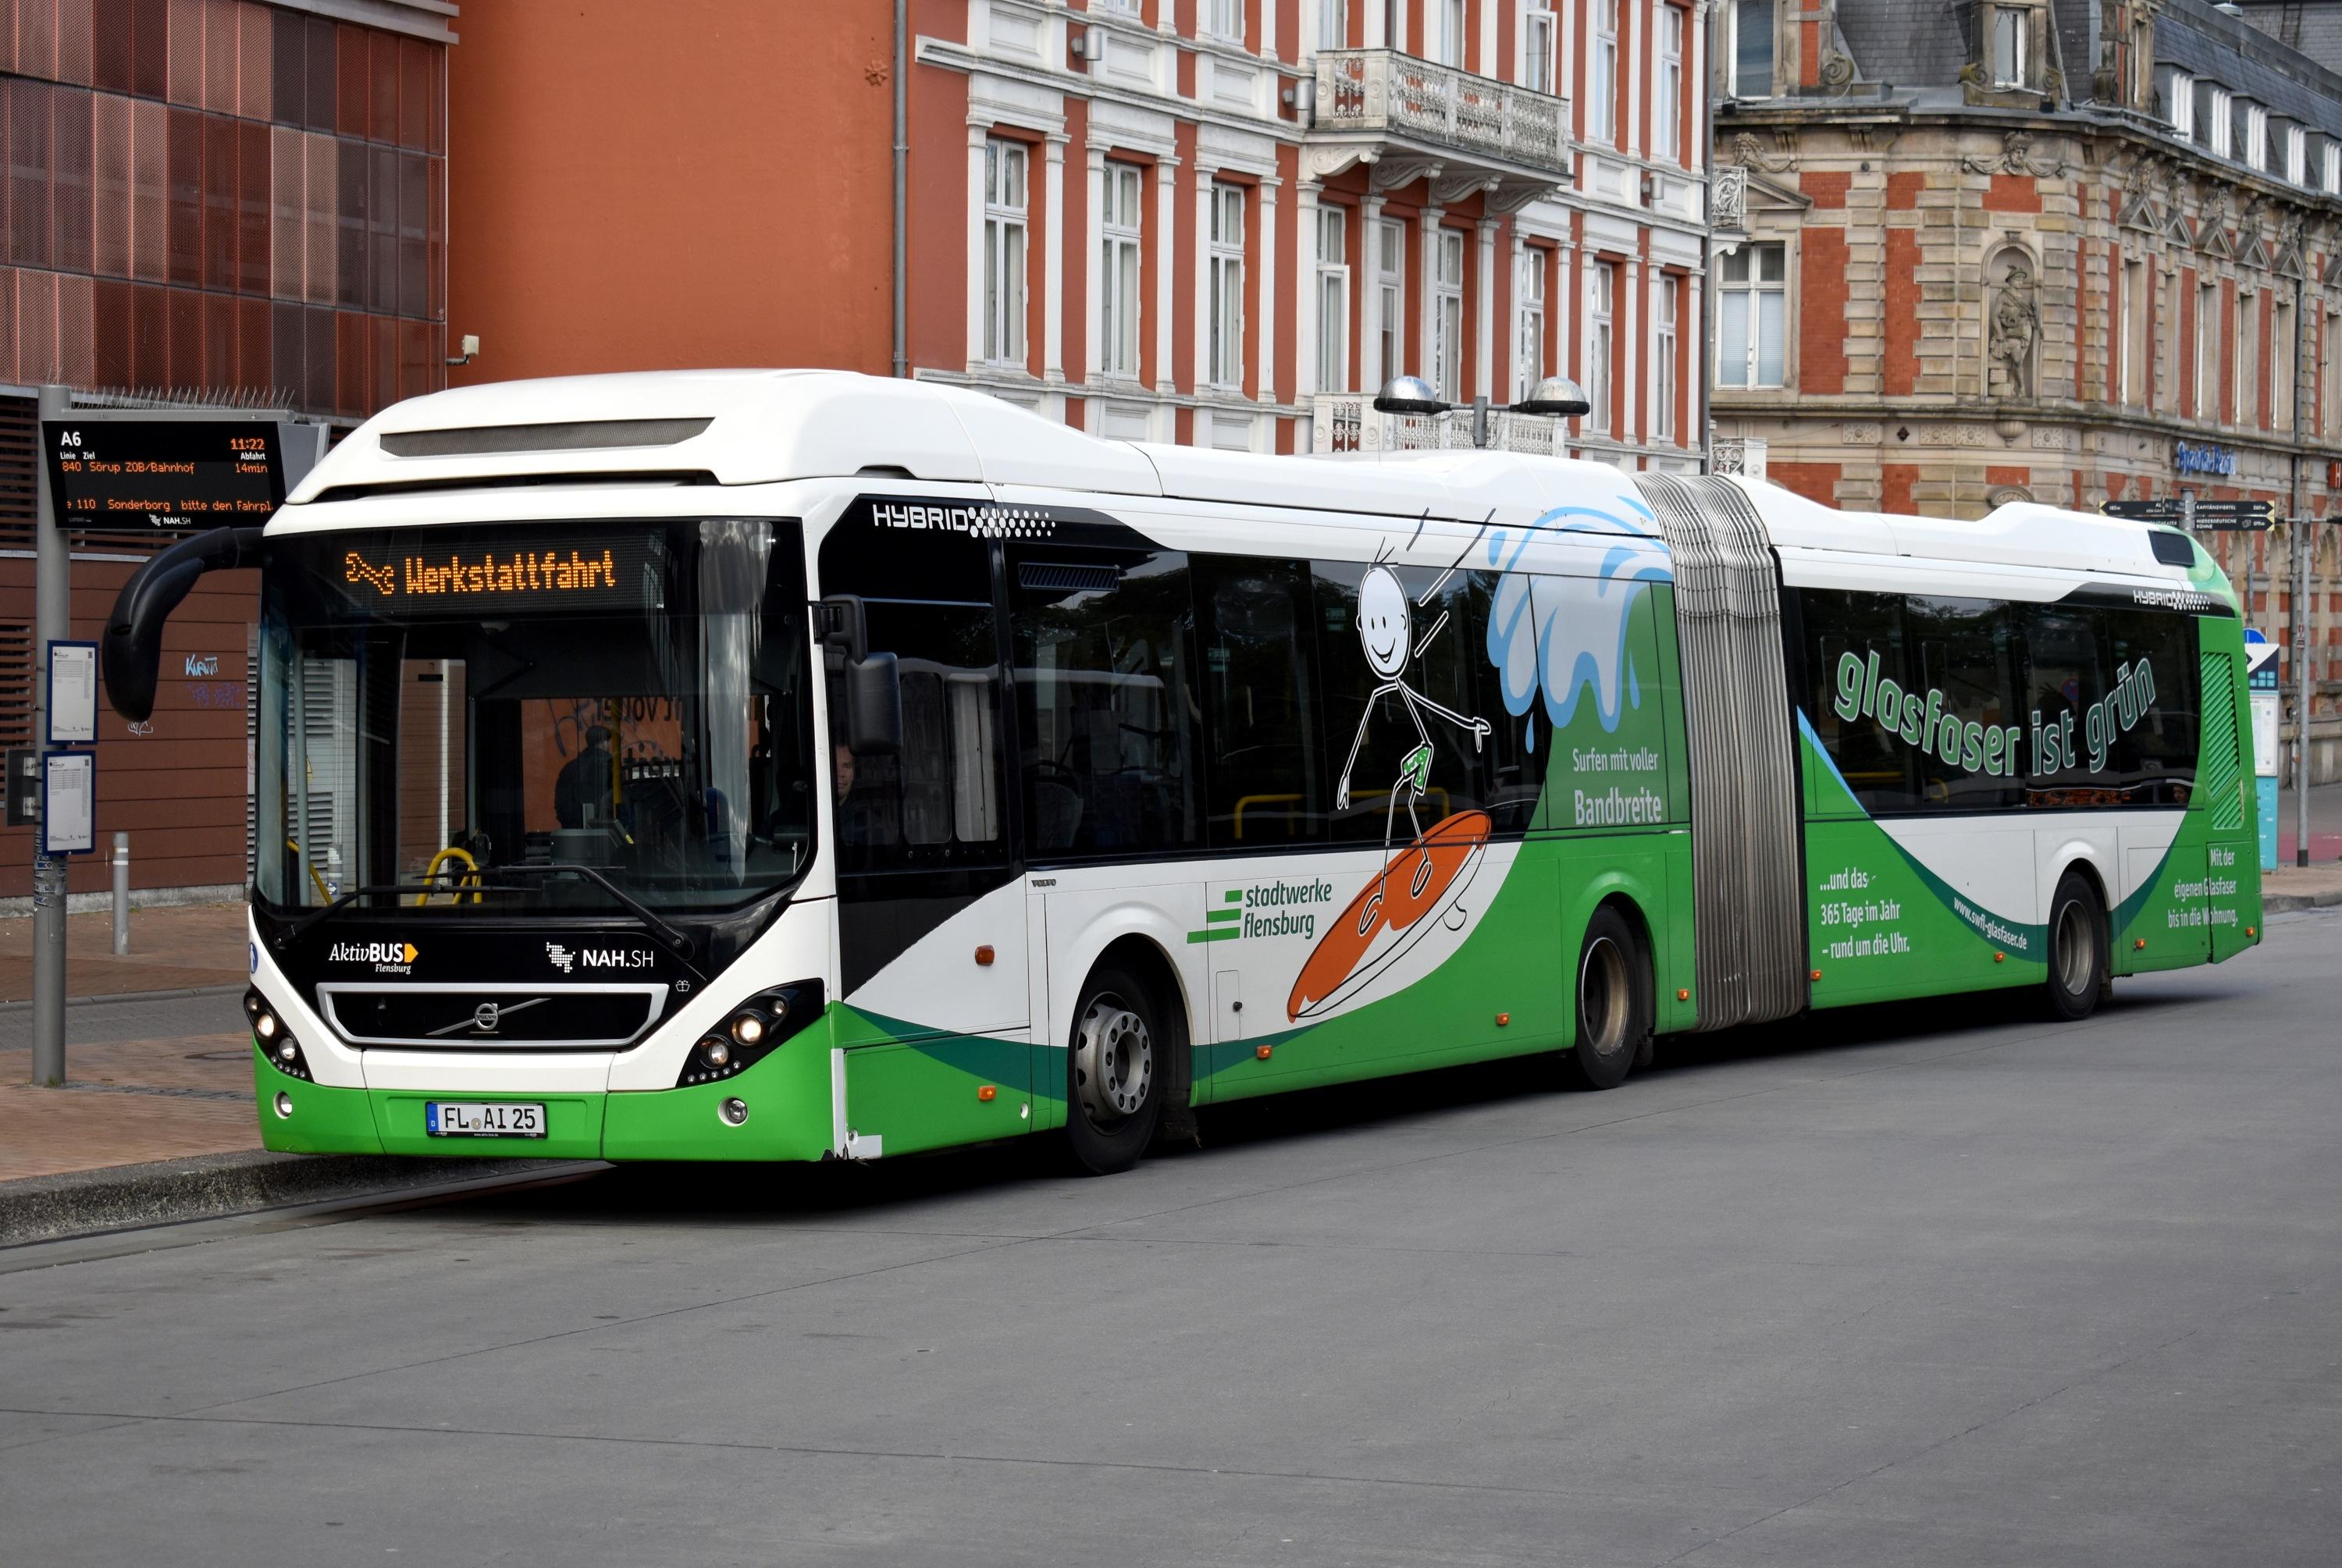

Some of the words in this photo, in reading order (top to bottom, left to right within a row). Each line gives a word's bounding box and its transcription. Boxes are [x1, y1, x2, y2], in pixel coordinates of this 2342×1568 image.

[61, 431, 82, 446] A6
[230, 439, 265, 450] 11:22
[83, 451, 95, 460] Ziel
[240, 452, 265, 460] Abfahrt
[62, 461, 82, 471] 840
[90, 462, 121, 474] Sörup
[125, 462, 194, 475] ZOB/Bahnhof
[235, 463, 268, 473] 14min
[77, 500, 96, 509] 110
[109, 500, 170, 512] Sonderborg
[180, 500, 208, 510] bitte
[212, 501, 233, 510] den
[237, 501, 273, 513] Fahrpl
[872, 503, 969, 532] HYBRID
[163, 517, 191, 525] NAH.SH
[406, 550, 616, 594] Werkstattfahrt
[2133, 589, 2173, 607] HYBRID
[1834, 649, 2020, 777] glasfaser
[2031, 708, 2076, 777] ist
[2087, 657, 2156, 774] grün
[1573, 747, 1608, 772] Surfen
[1611, 747, 1628, 771] mit
[1630, 746, 1658, 771] voller
[1575, 786, 1661, 825] Bandbreite
[2210, 848, 2223, 866] Mit
[2223, 847, 2235, 866] der
[1851, 866, 1868, 889] das
[2174, 879, 2202, 902] eigenen
[2203, 876, 2237, 896] Glasfaser
[1245, 877, 1332, 908] stadtwerke
[1244, 910, 1315, 939] flensburg
[1821, 903, 1840, 925] 365
[1841, 901, 1863, 928] Tage
[1865, 900, 1878, 921] im
[1880, 898, 1900, 920] Jahr
[1954, 897, 2027, 950] www.swfl-glasfaser.de
[2168, 908, 2180, 928] bis
[2180, 908, 2188, 926] in
[2189, 907, 2201, 926] die
[2201, 905, 2238, 927] Wohnung.
[329, 942, 404, 962] AktivBUS
[1830, 935, 1853, 958] rund
[1856, 939, 1871, 957] um
[1873, 933, 1888, 955] die
[1890, 931, 1910, 954] Uhr.
[375, 963, 411, 975] Flensburg
[582, 949, 653, 968] NAH.SH
[444, 1108, 469, 1129] FL
[484, 1108, 507, 1129] AI
[512, 1108, 536, 1129] 25
